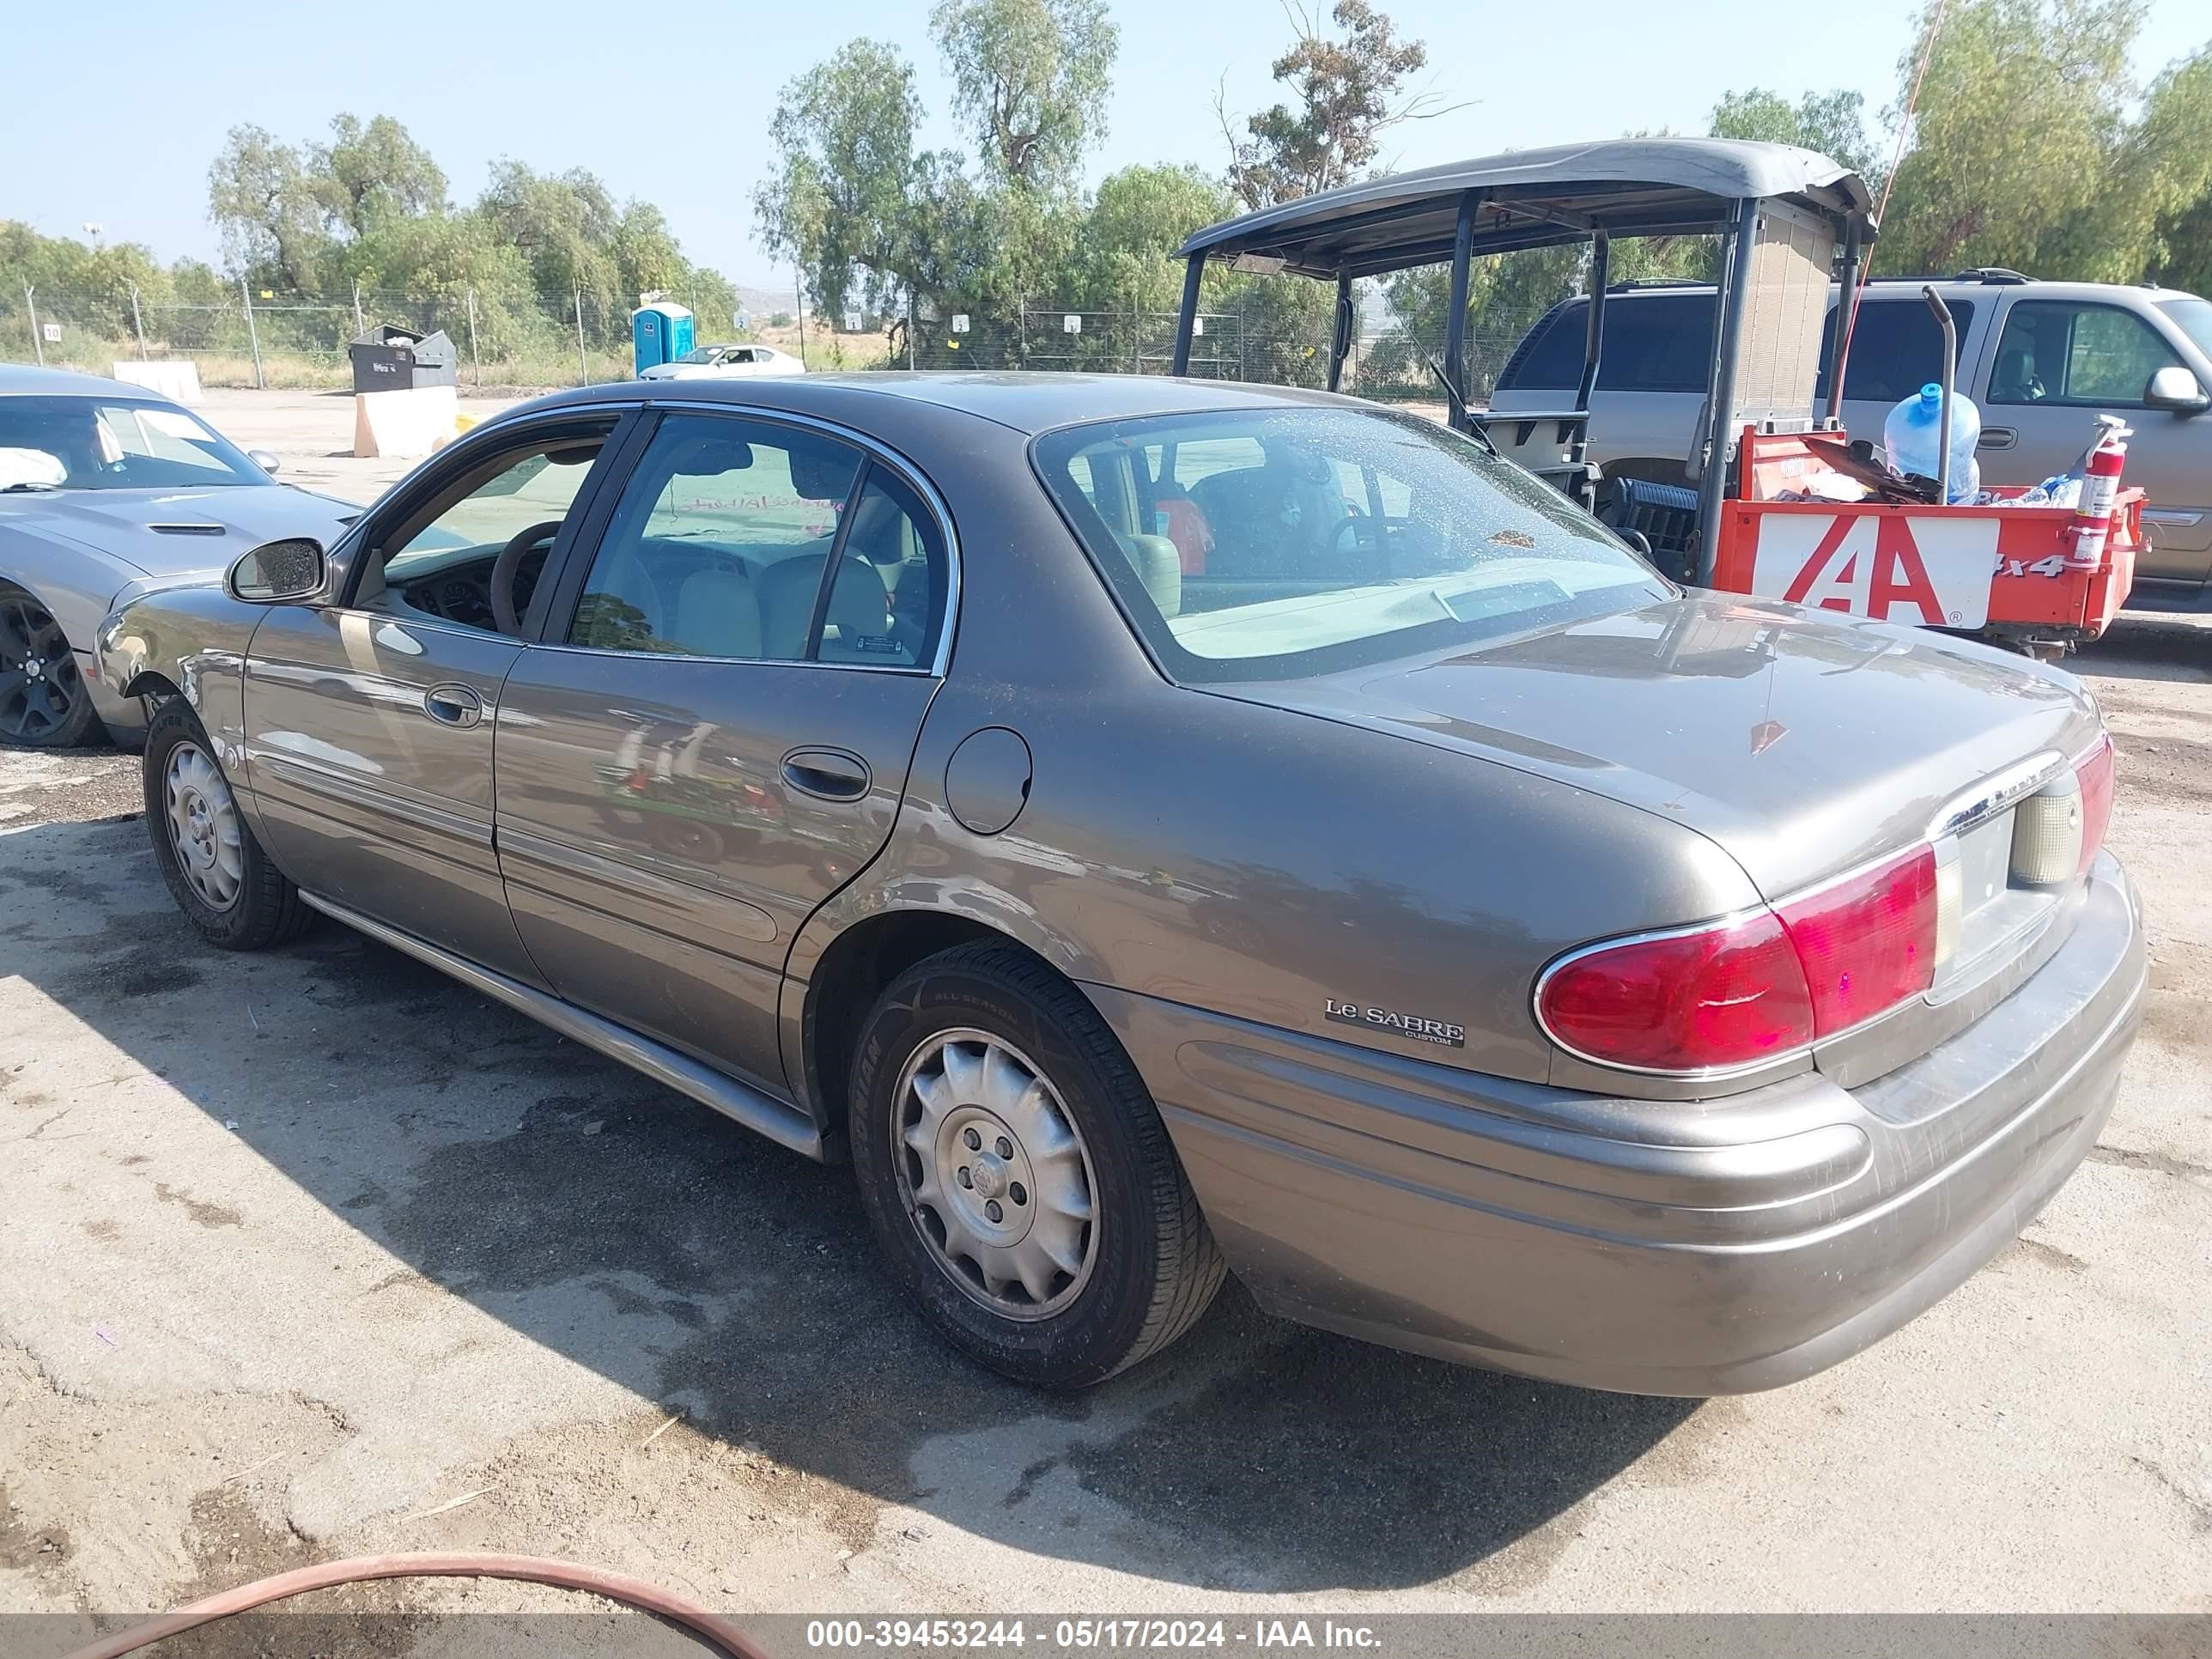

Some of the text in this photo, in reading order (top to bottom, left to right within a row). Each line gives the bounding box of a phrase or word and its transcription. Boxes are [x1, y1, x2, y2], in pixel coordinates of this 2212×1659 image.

[46, 328, 59, 338] 10
[1365, 1007, 1465, 1041] SABRE
[1405, 1030, 1453, 1047] CUSTOM
